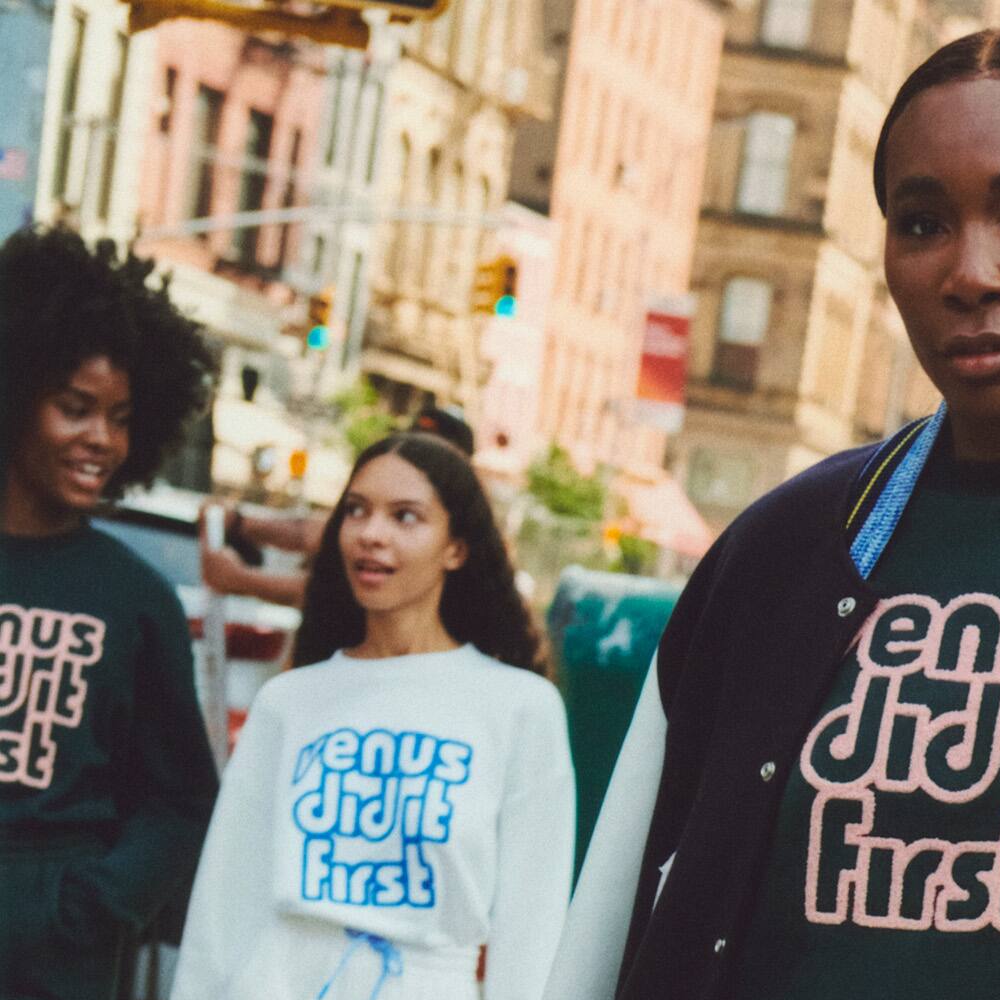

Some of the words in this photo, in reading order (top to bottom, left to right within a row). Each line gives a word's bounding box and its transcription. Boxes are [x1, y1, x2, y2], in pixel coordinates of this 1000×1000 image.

[0, 603, 106, 666] nus
[293, 769, 400, 842] did
[401, 775, 453, 844] it
